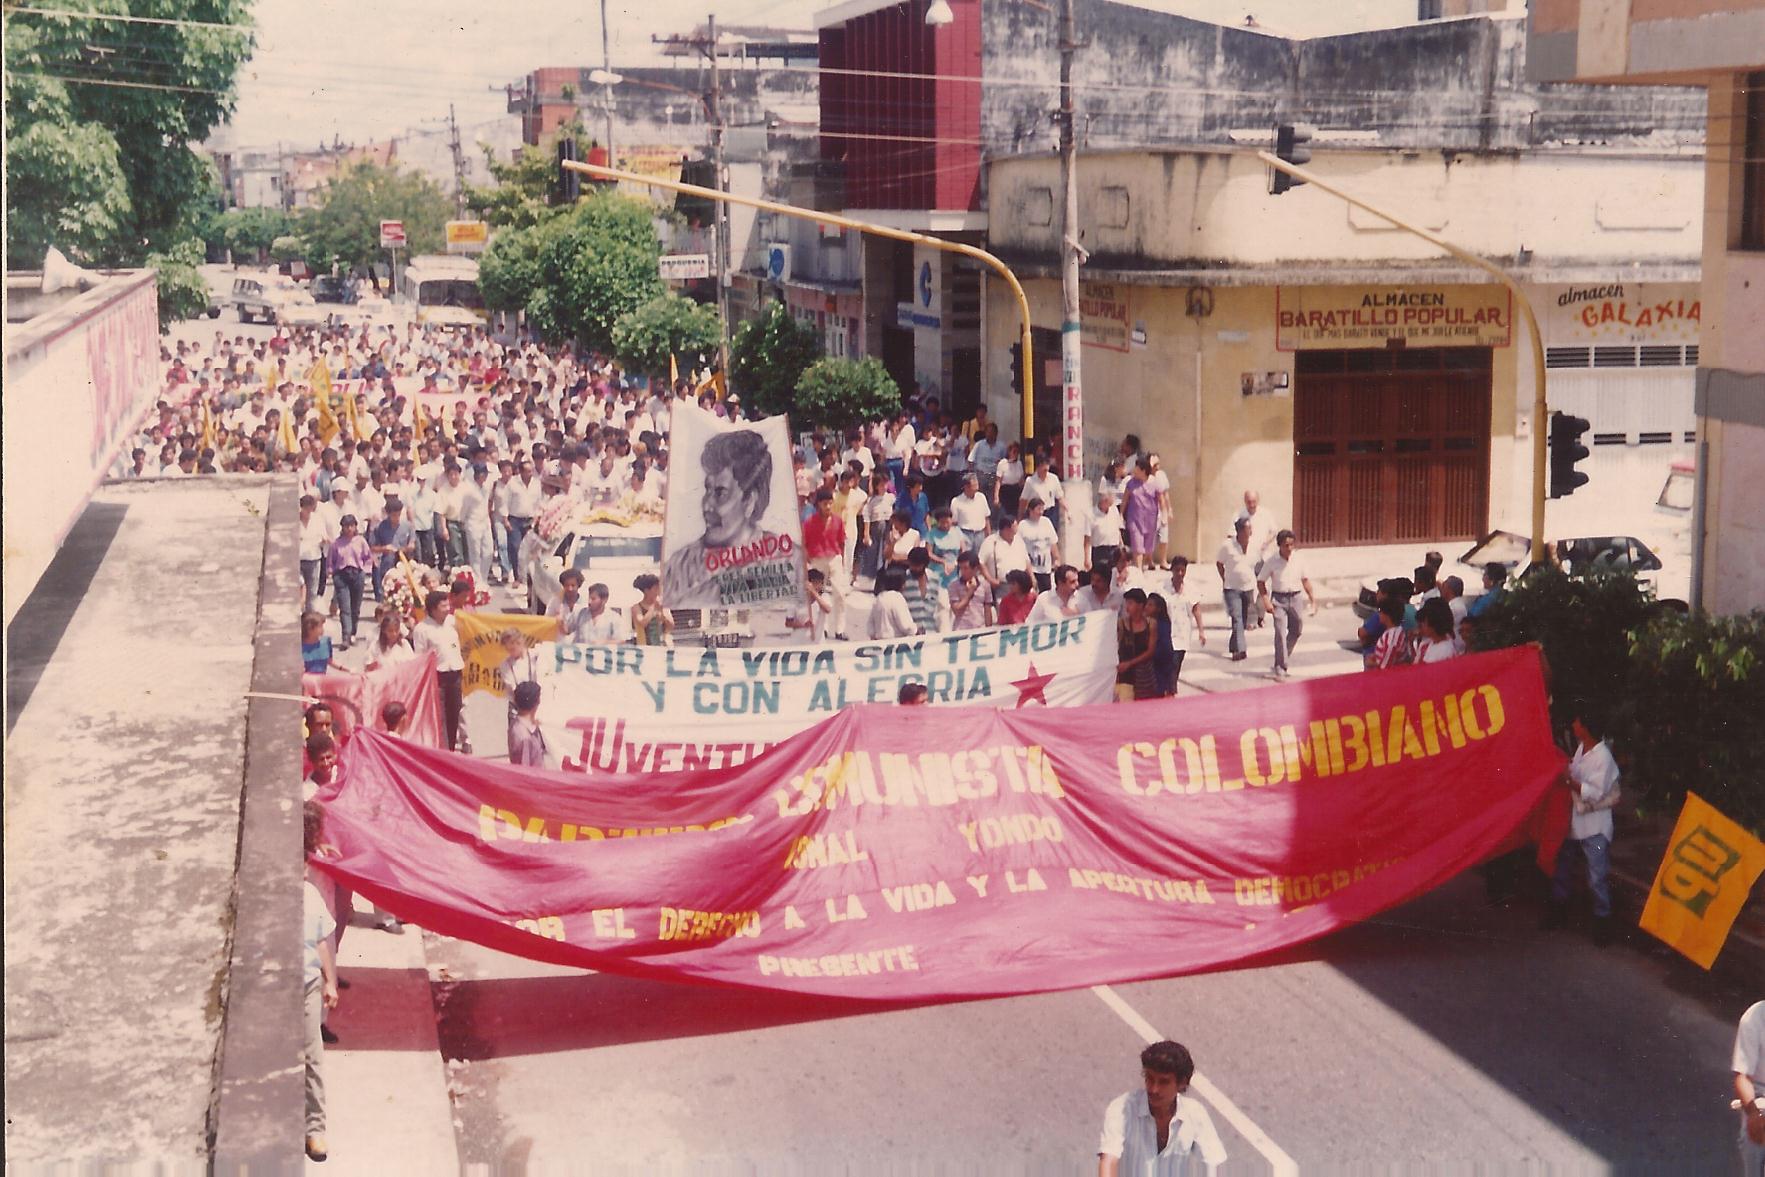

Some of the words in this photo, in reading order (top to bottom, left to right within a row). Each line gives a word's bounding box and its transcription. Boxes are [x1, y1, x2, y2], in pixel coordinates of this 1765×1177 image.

[1361, 293, 1444, 307] ALMACEN
[1558, 284, 1624, 307] almacen
[1280, 309, 1399, 331] BARATILLO
[1404, 307, 1509, 327] POPULAR
[1582, 300, 1700, 328] GALAXIA
[706, 533, 793, 573] ORLANDO
[555, 644, 644, 675] POR
[666, 648, 721, 677] LA
[742, 649, 836, 677] VIDA
[854, 641, 924, 672] SIN
[942, 616, 1086, 664] TEMOR
[641, 681, 666, 713] Y
[693, 680, 780, 714] CON
[1116, 684, 1505, 796] COLOMBIANO
[959, 813, 1064, 852] YONDO
[591, 908, 635, 939] EL
[784, 905, 806, 930] A
[825, 894, 868, 923] LA
[881, 880, 956, 913] VIDA
[966, 874, 989, 898] Y
[1005, 868, 1047, 893] LA
[1069, 867, 1215, 905] APERTURA
[758, 945, 919, 977] PRESENTE
